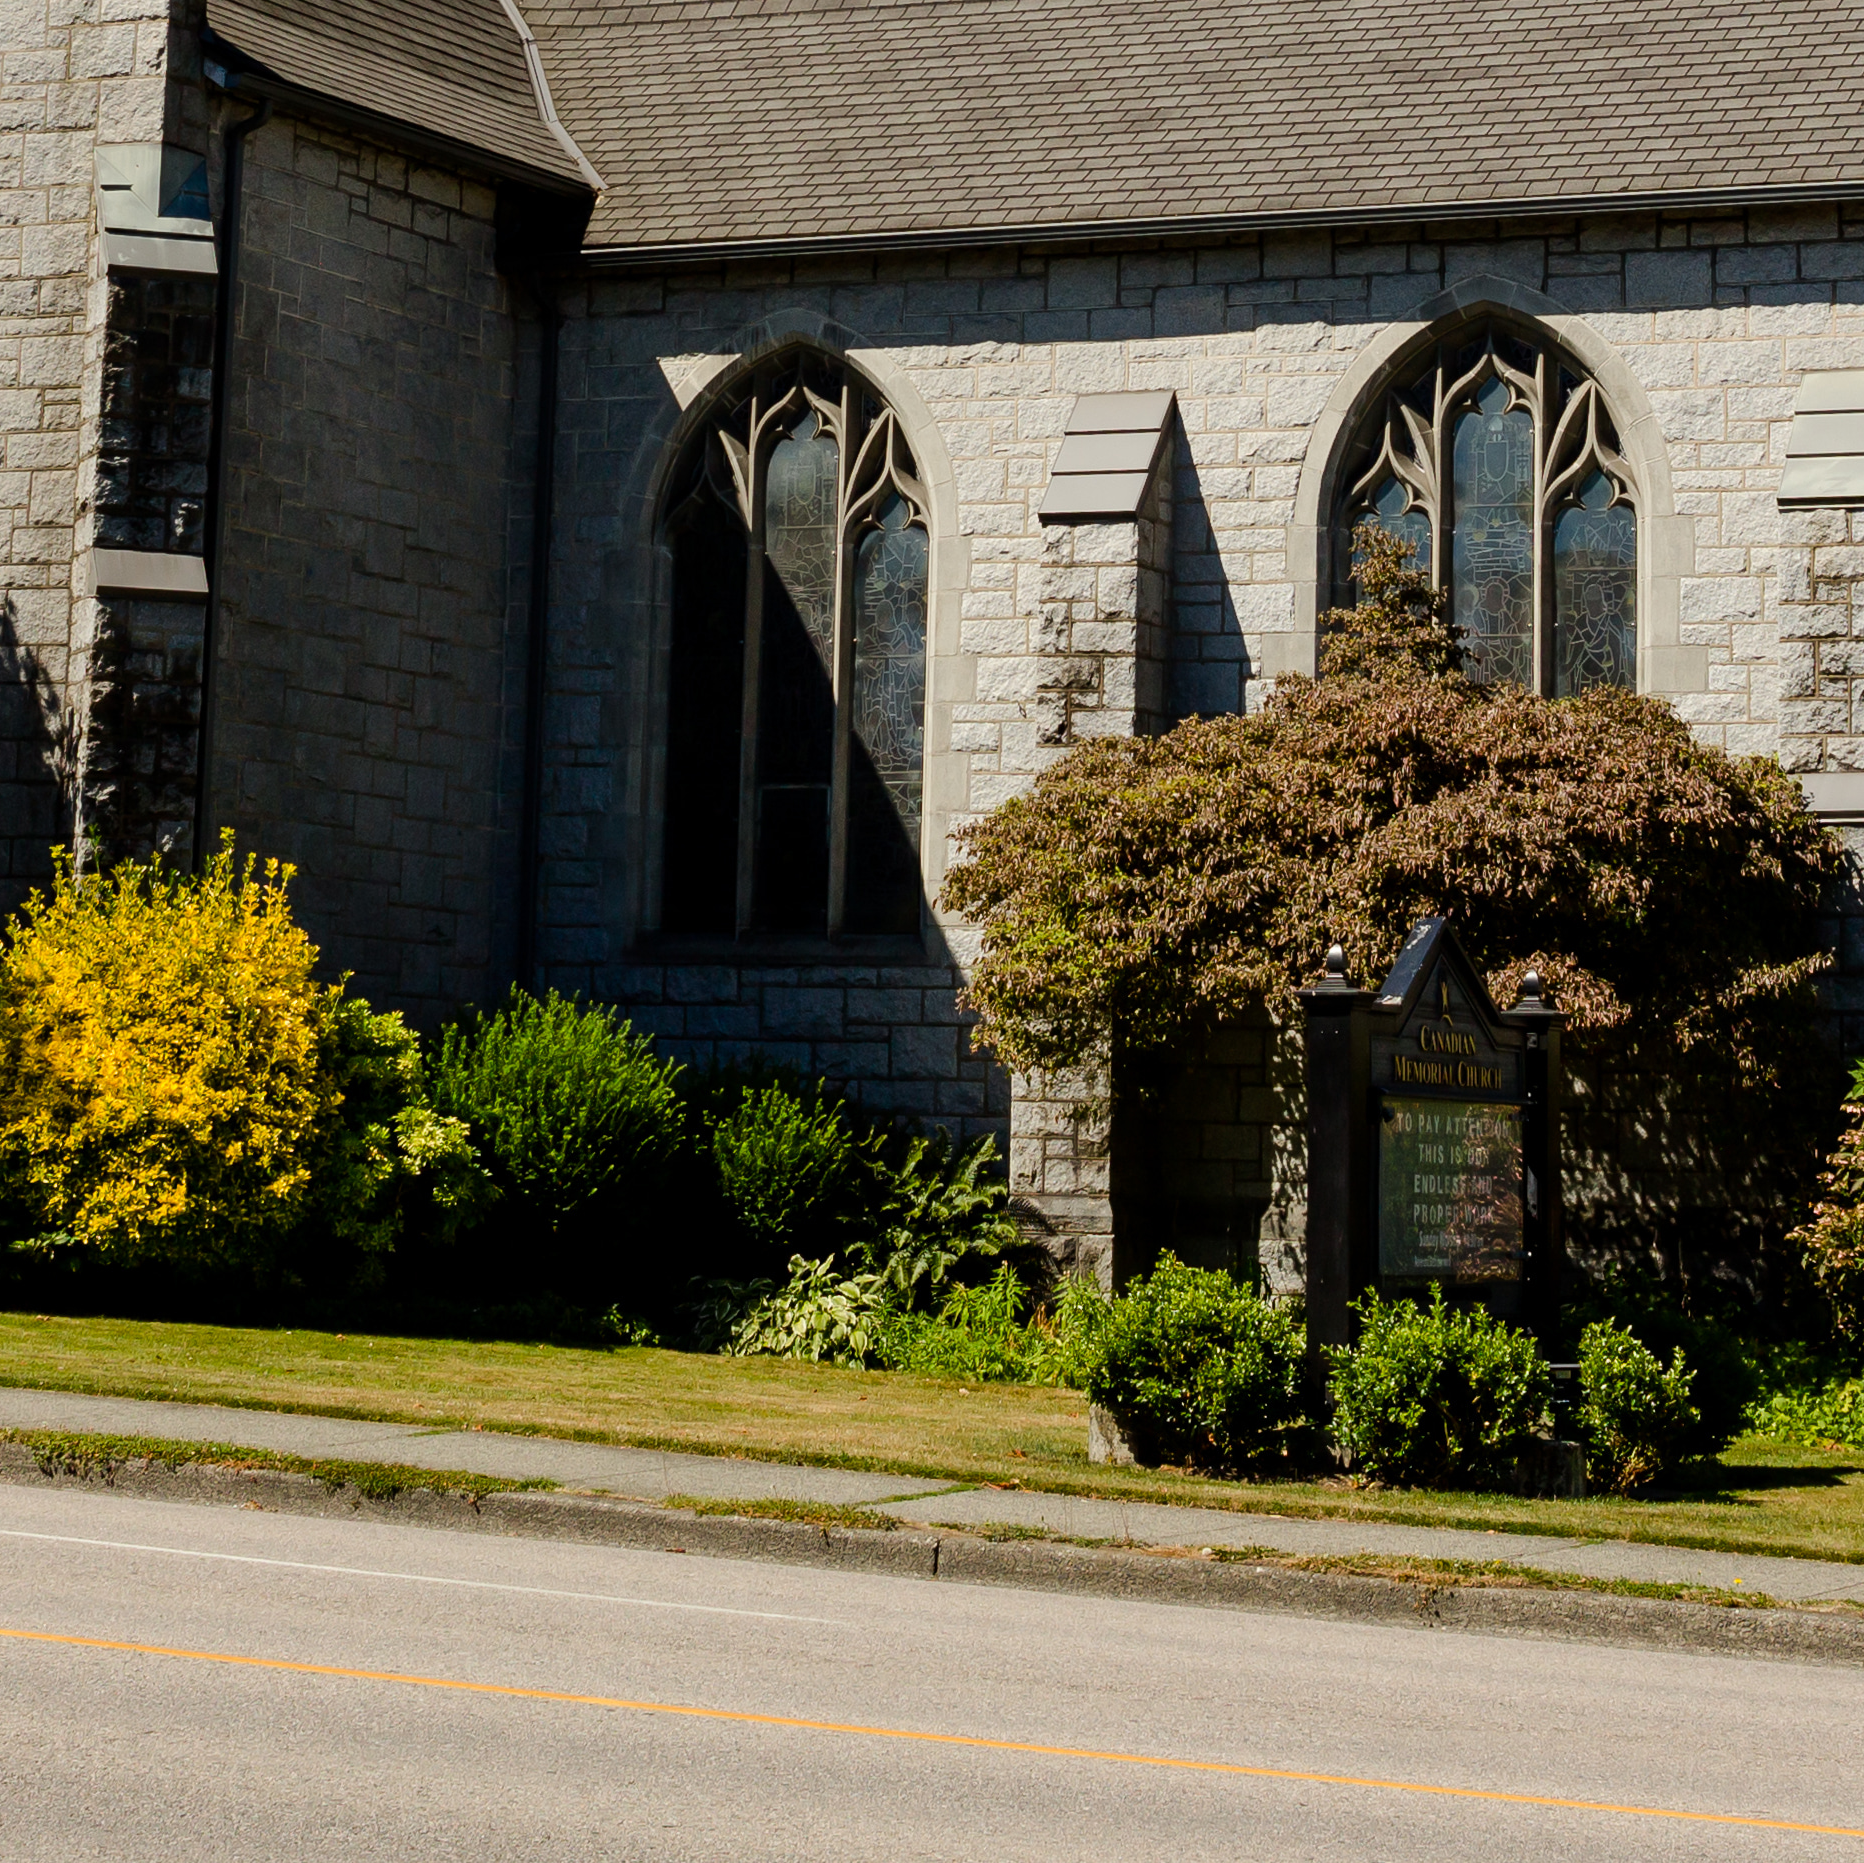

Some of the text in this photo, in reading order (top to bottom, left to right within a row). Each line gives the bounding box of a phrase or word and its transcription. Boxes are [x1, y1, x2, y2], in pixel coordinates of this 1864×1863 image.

[1397, 1112, 1413, 1132] TO
[1418, 1114, 1440, 1134] PAY
[1419, 1144, 1444, 1164] THIS
[1450, 1146, 1463, 1165] IS
[1414, 1174, 1493, 1196] ENDLESS AND
[1413, 1203, 1459, 1225] PROPER
